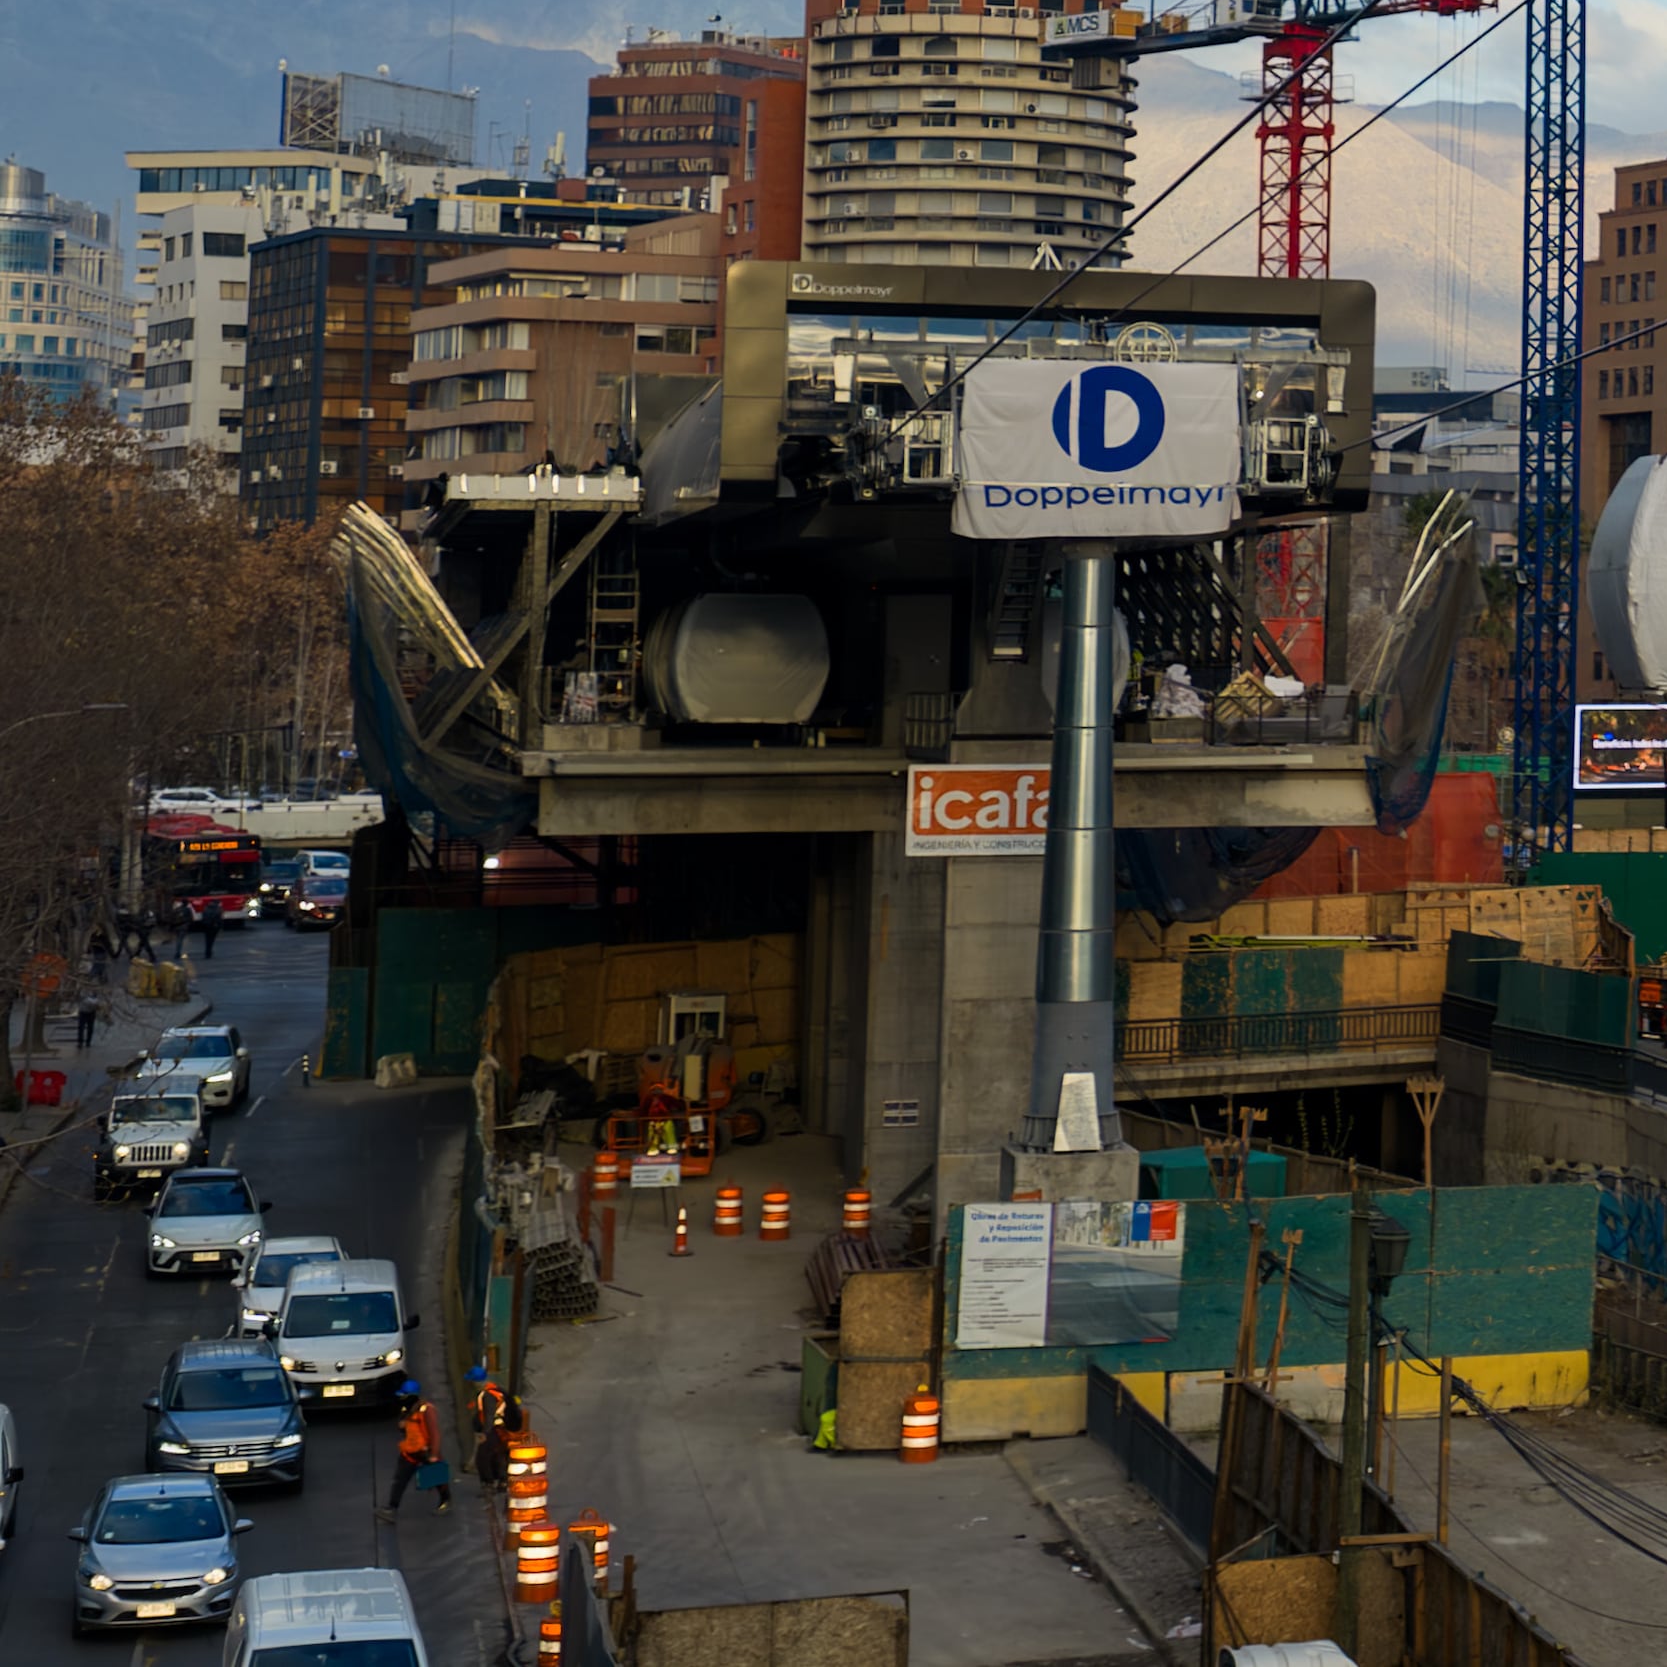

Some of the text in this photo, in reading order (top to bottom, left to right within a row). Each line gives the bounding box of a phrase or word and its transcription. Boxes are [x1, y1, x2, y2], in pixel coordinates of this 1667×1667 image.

[1067, 15, 1099, 34] MCS
[813, 282, 893, 297] Doppelmayr
[913, 838, 971, 849] INGENIERÍA
[973, 839, 981, 848] Y
[998, 1212, 1008, 1220] de
[996, 1224, 1044, 1232] Reposición
[992, 1235, 1043, 1243] Pavimentos
